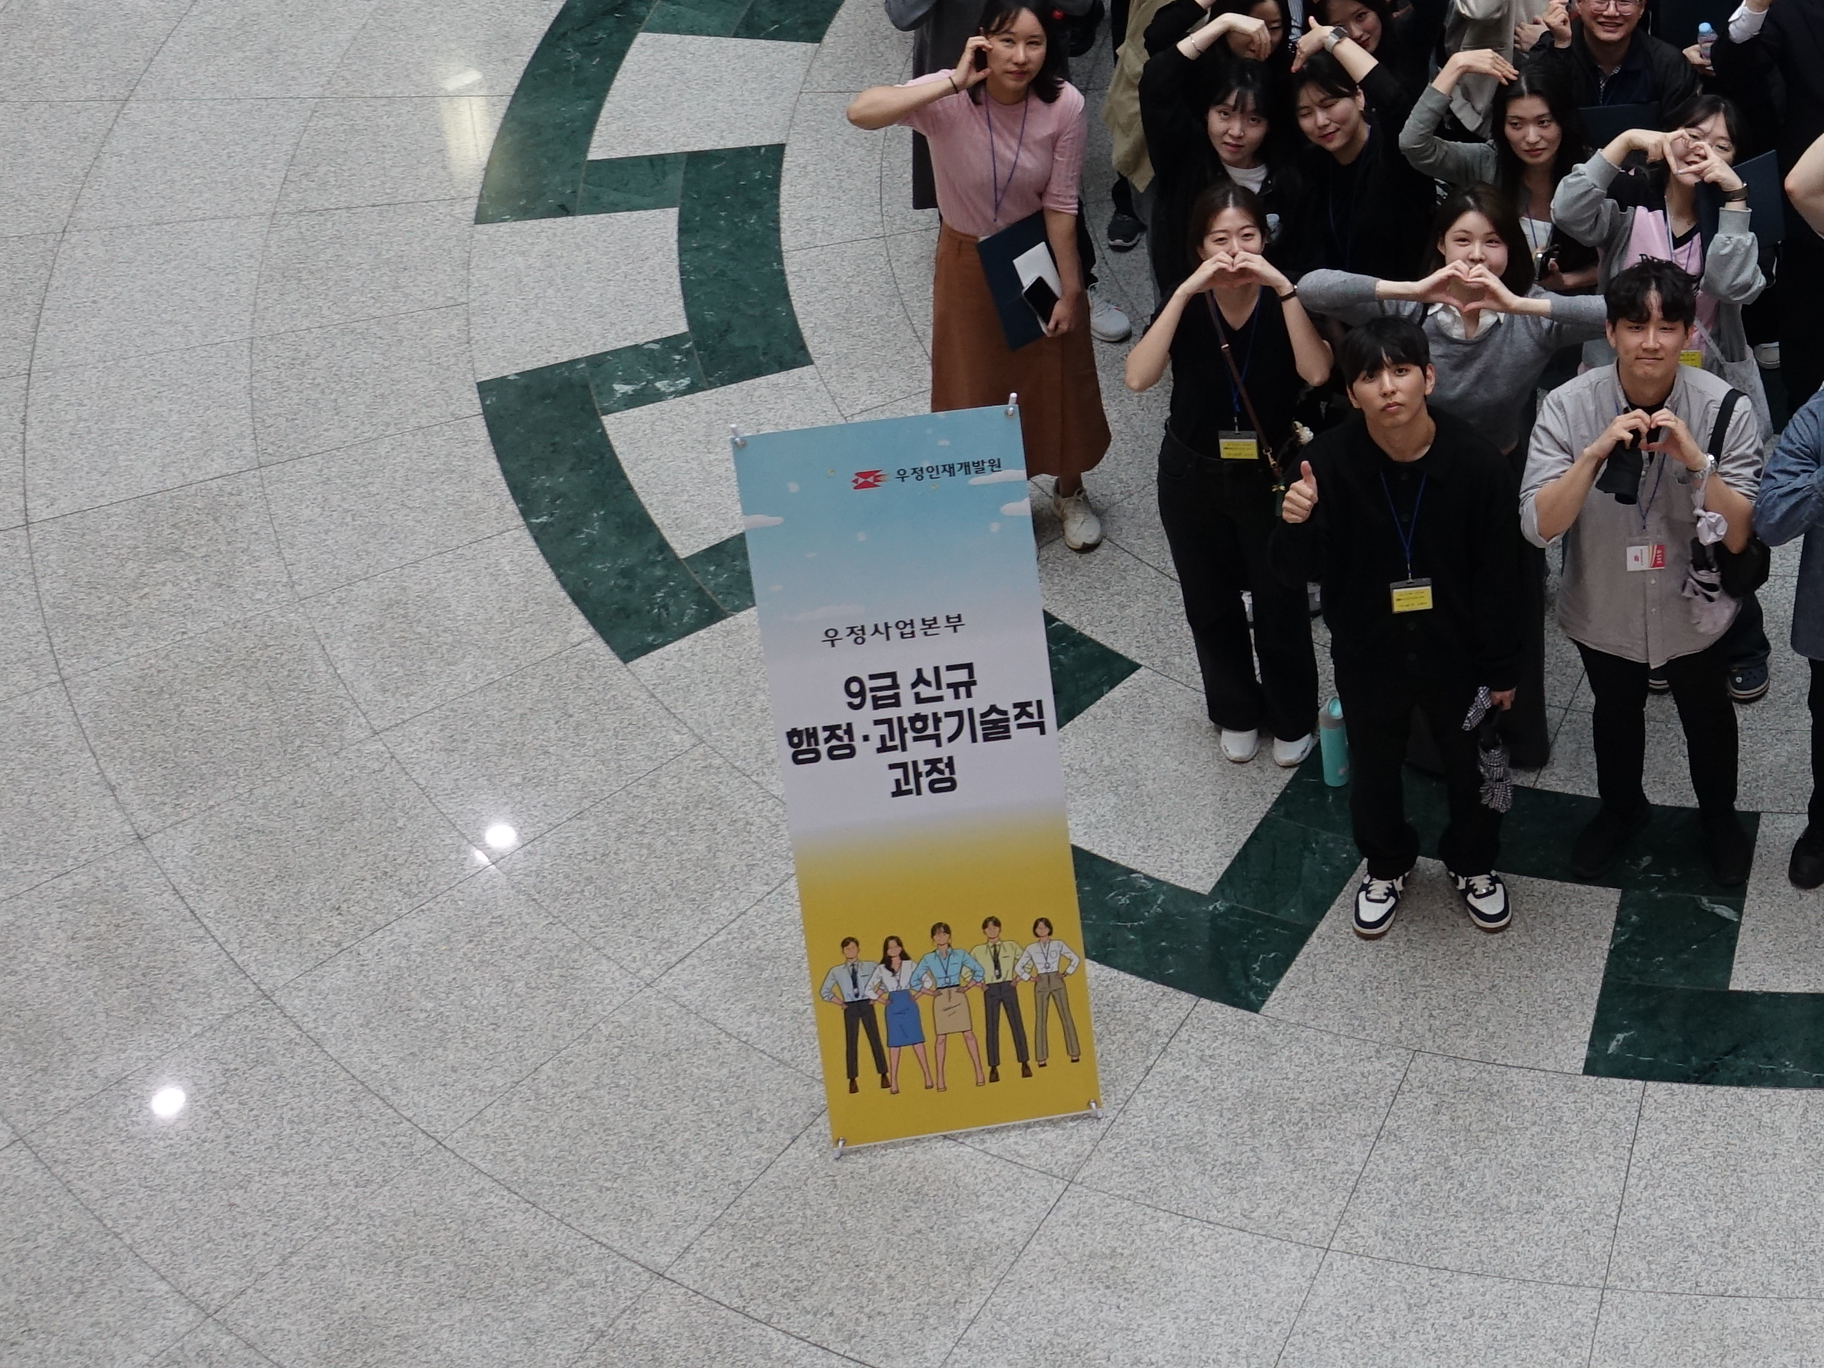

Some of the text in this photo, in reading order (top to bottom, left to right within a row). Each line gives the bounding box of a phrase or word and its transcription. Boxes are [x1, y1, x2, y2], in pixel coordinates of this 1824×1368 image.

[895, 457, 1003, 484] 우정인재개발원
[821, 613, 967, 648] 우정사업본부
[844, 662, 978, 711] 9급 신규
[888, 755, 959, 799] 과정
